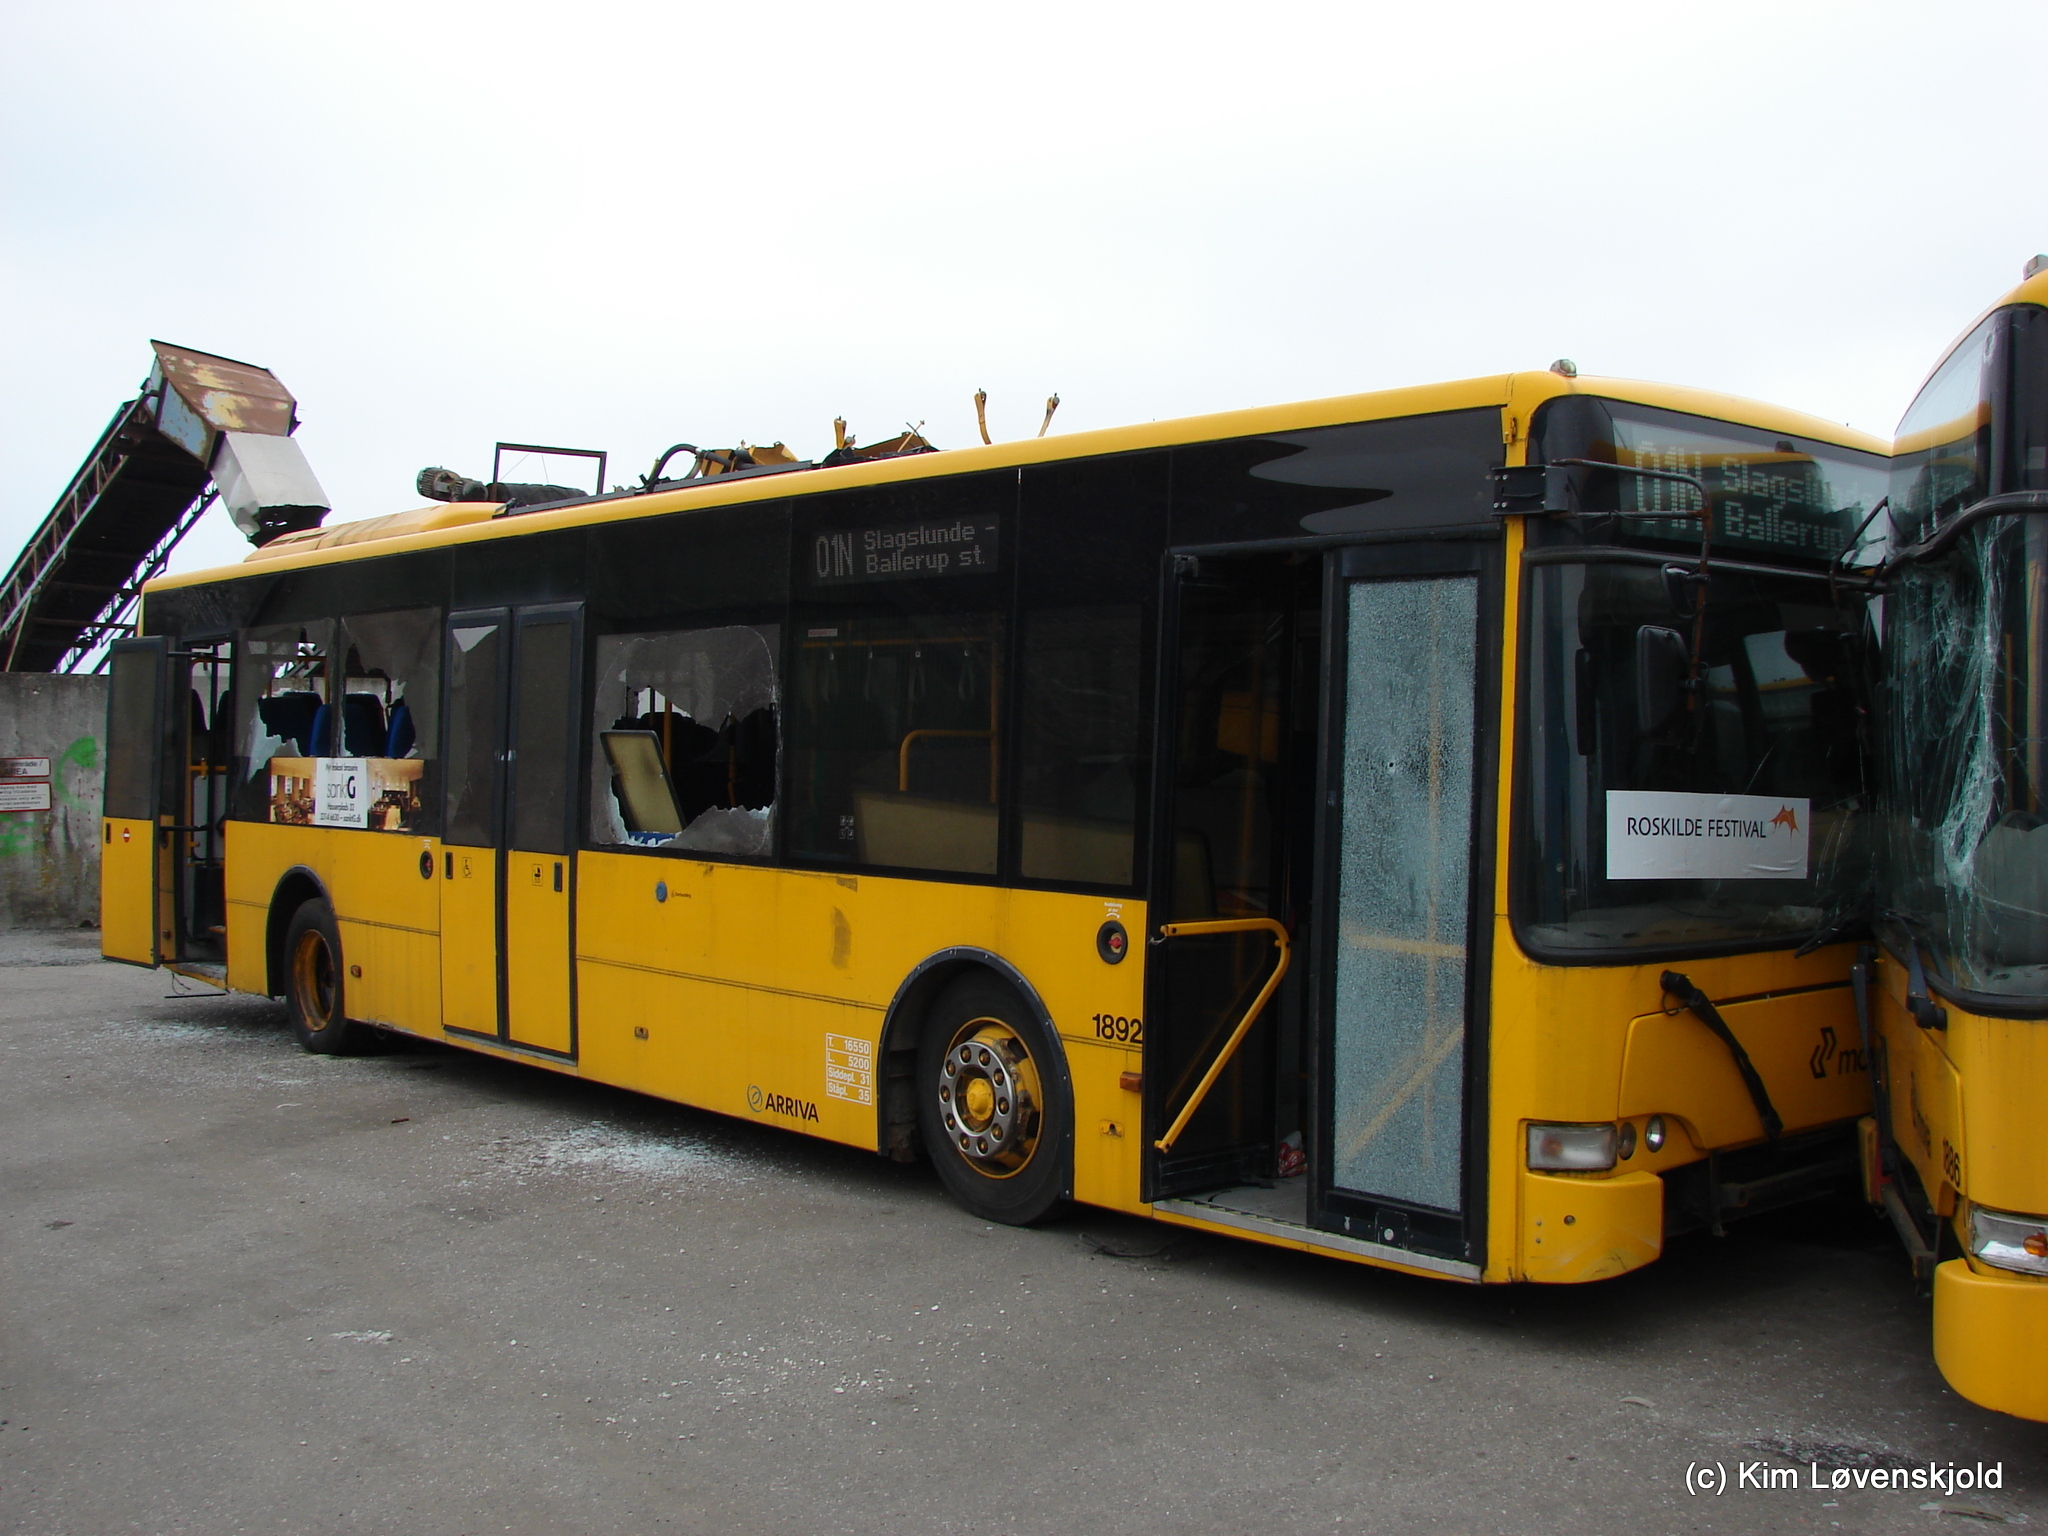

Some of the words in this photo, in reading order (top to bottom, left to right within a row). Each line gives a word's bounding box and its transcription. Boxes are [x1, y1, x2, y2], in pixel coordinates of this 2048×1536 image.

[864, 521, 975, 551] Slagslunde
[816, 533, 854, 577] 01N
[866, 550, 950, 573] Ballerup
[959, 545, 986, 567] st.
[1627, 817, 1702, 837] ROSKILDE
[1708, 819, 1767, 838] FESTIVAL
[1092, 1013, 1143, 1044] 1892
[844, 1039, 870, 1055] 16550
[848, 1056, 870, 1070] 5200
[828, 1066, 855, 1082] Siddepl.
[860, 1074, 870, 1086] 31
[765, 1092, 819, 1123] ARRIVA
[858, 1089, 870, 1102] 35
